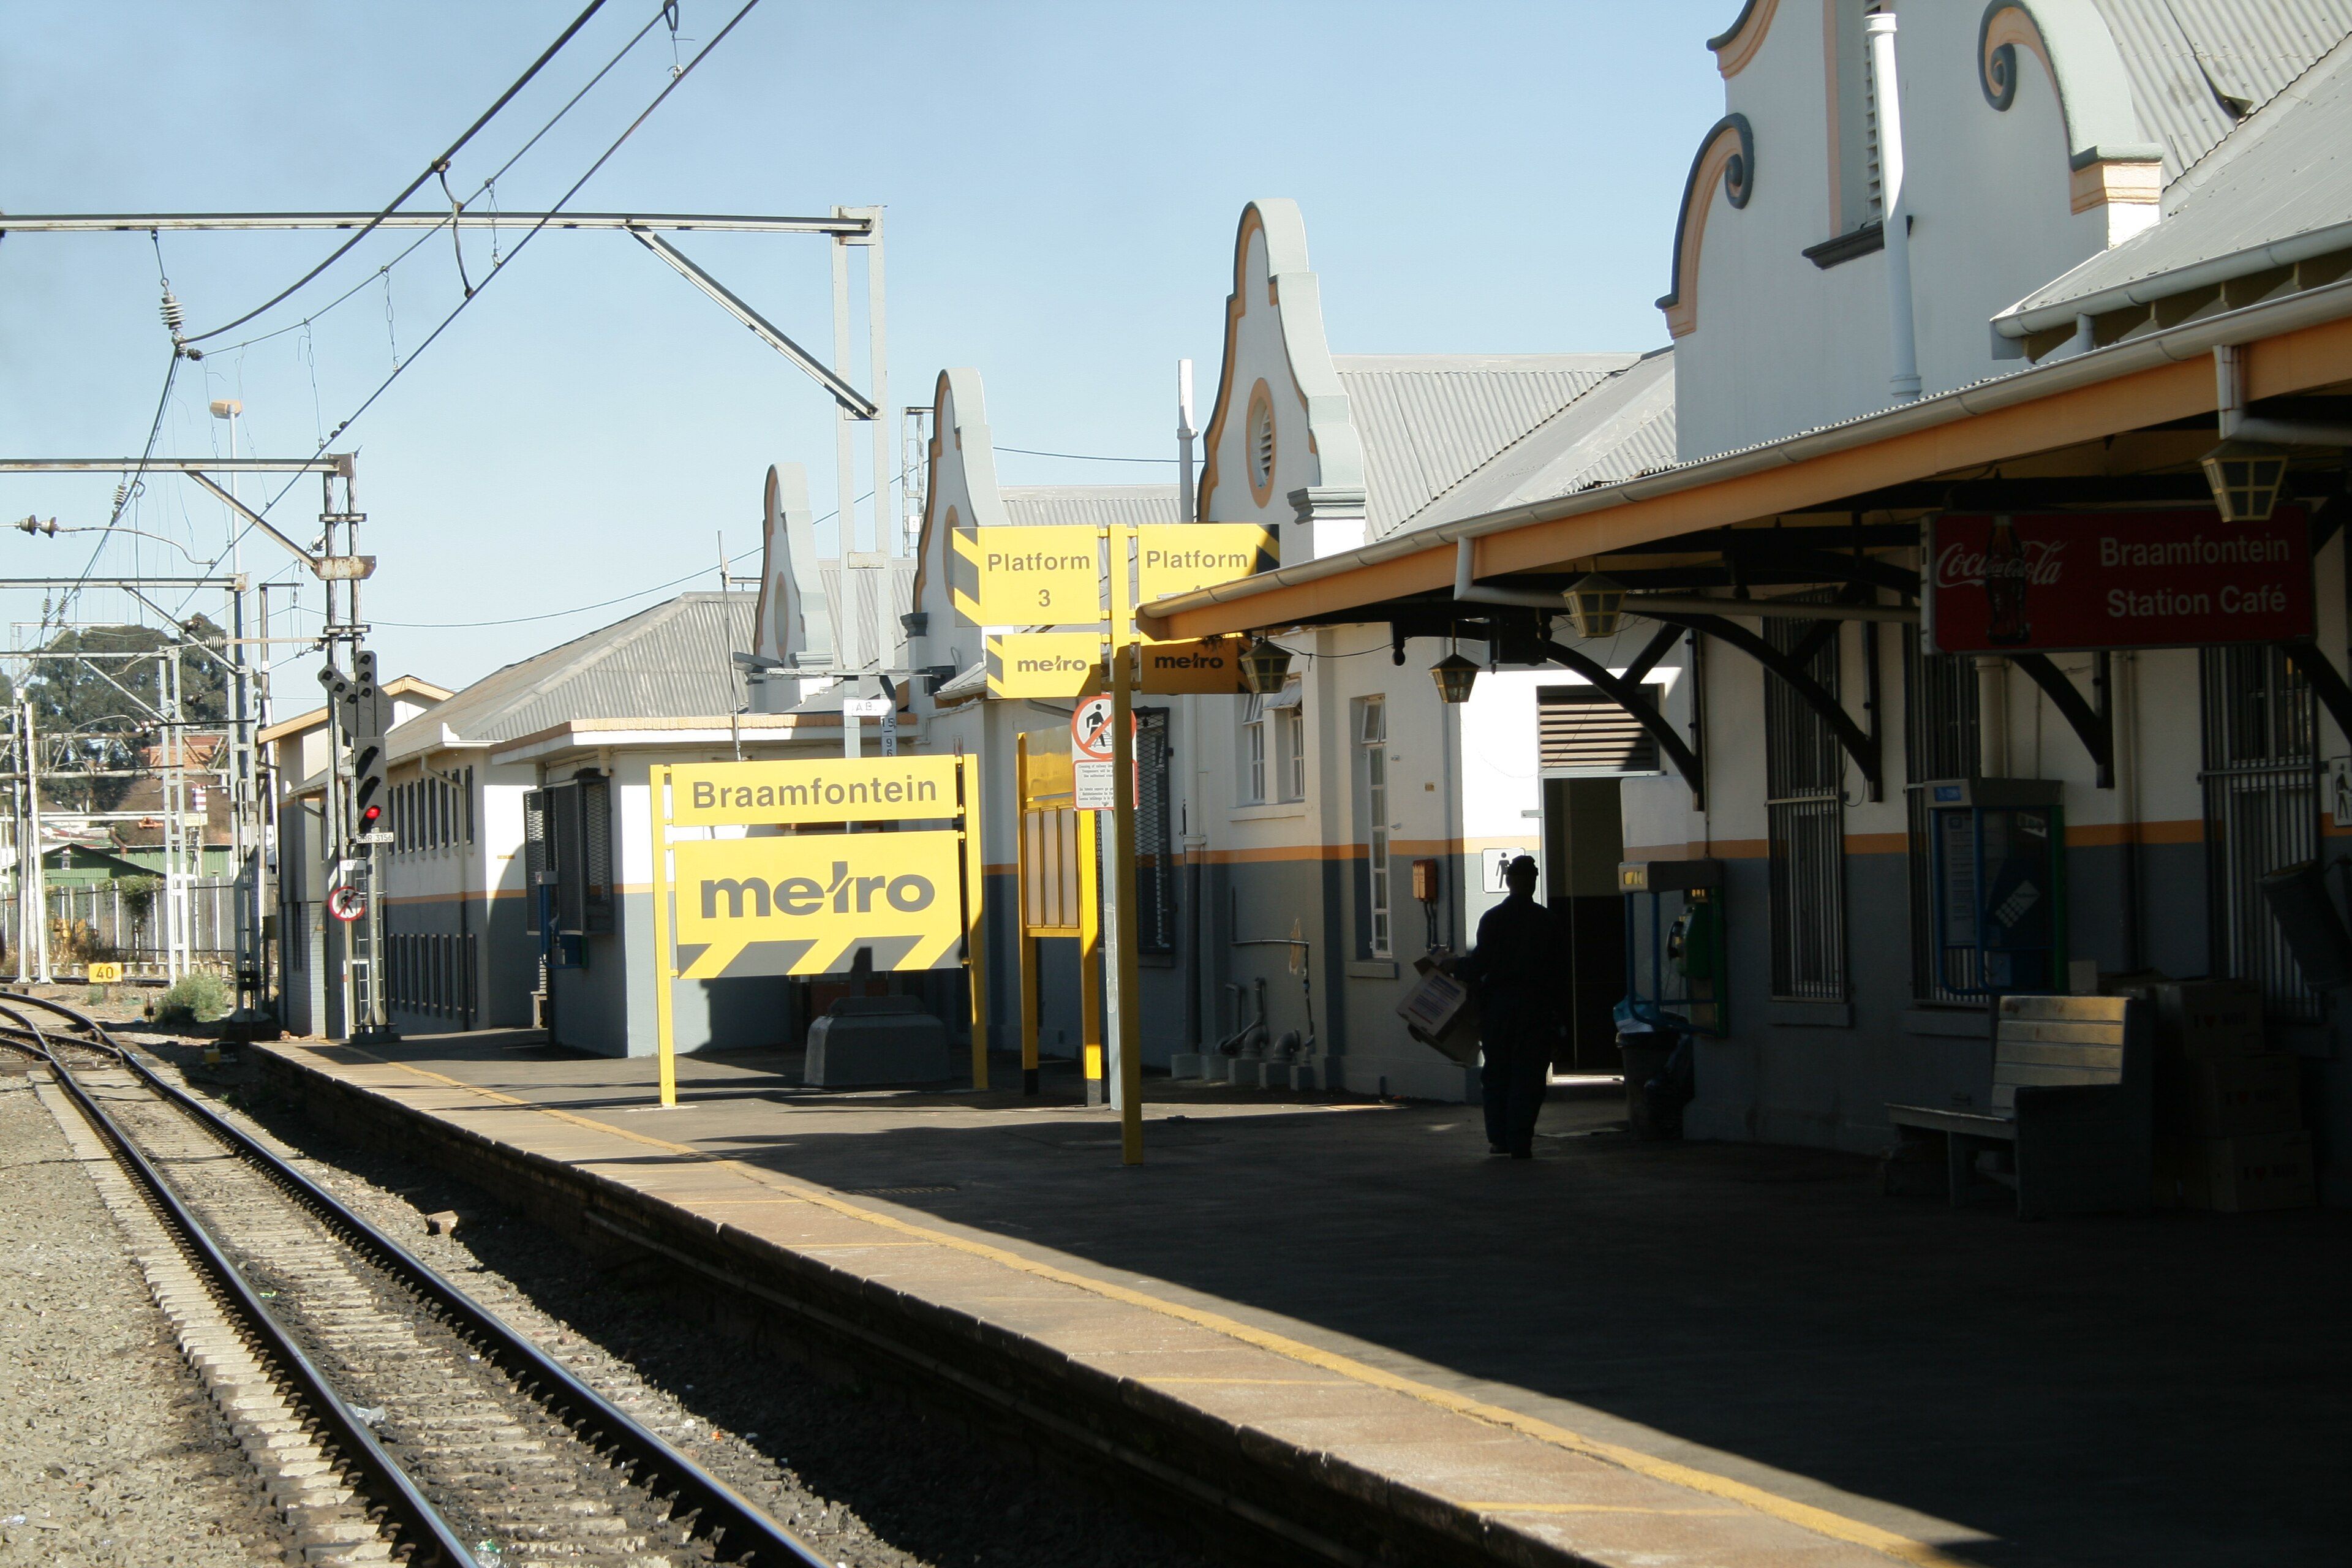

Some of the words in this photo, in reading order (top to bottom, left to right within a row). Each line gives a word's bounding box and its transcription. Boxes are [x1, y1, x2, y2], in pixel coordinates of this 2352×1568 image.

[1146, 550, 1248, 568] Platform
[2099, 533, 2290, 567] Braamfontein
[987, 552, 1090, 571] Platform
[1038, 589, 1051, 607] 3
[2106, 587, 2210, 618] Station
[2218, 583, 2288, 614] Café
[1017, 655, 1087, 672] metro
[1154, 652, 1224, 669] metro
[693, 775, 936, 809] Braamfontein
[700, 861, 935, 919] metro
[96, 967, 113, 979] 40
